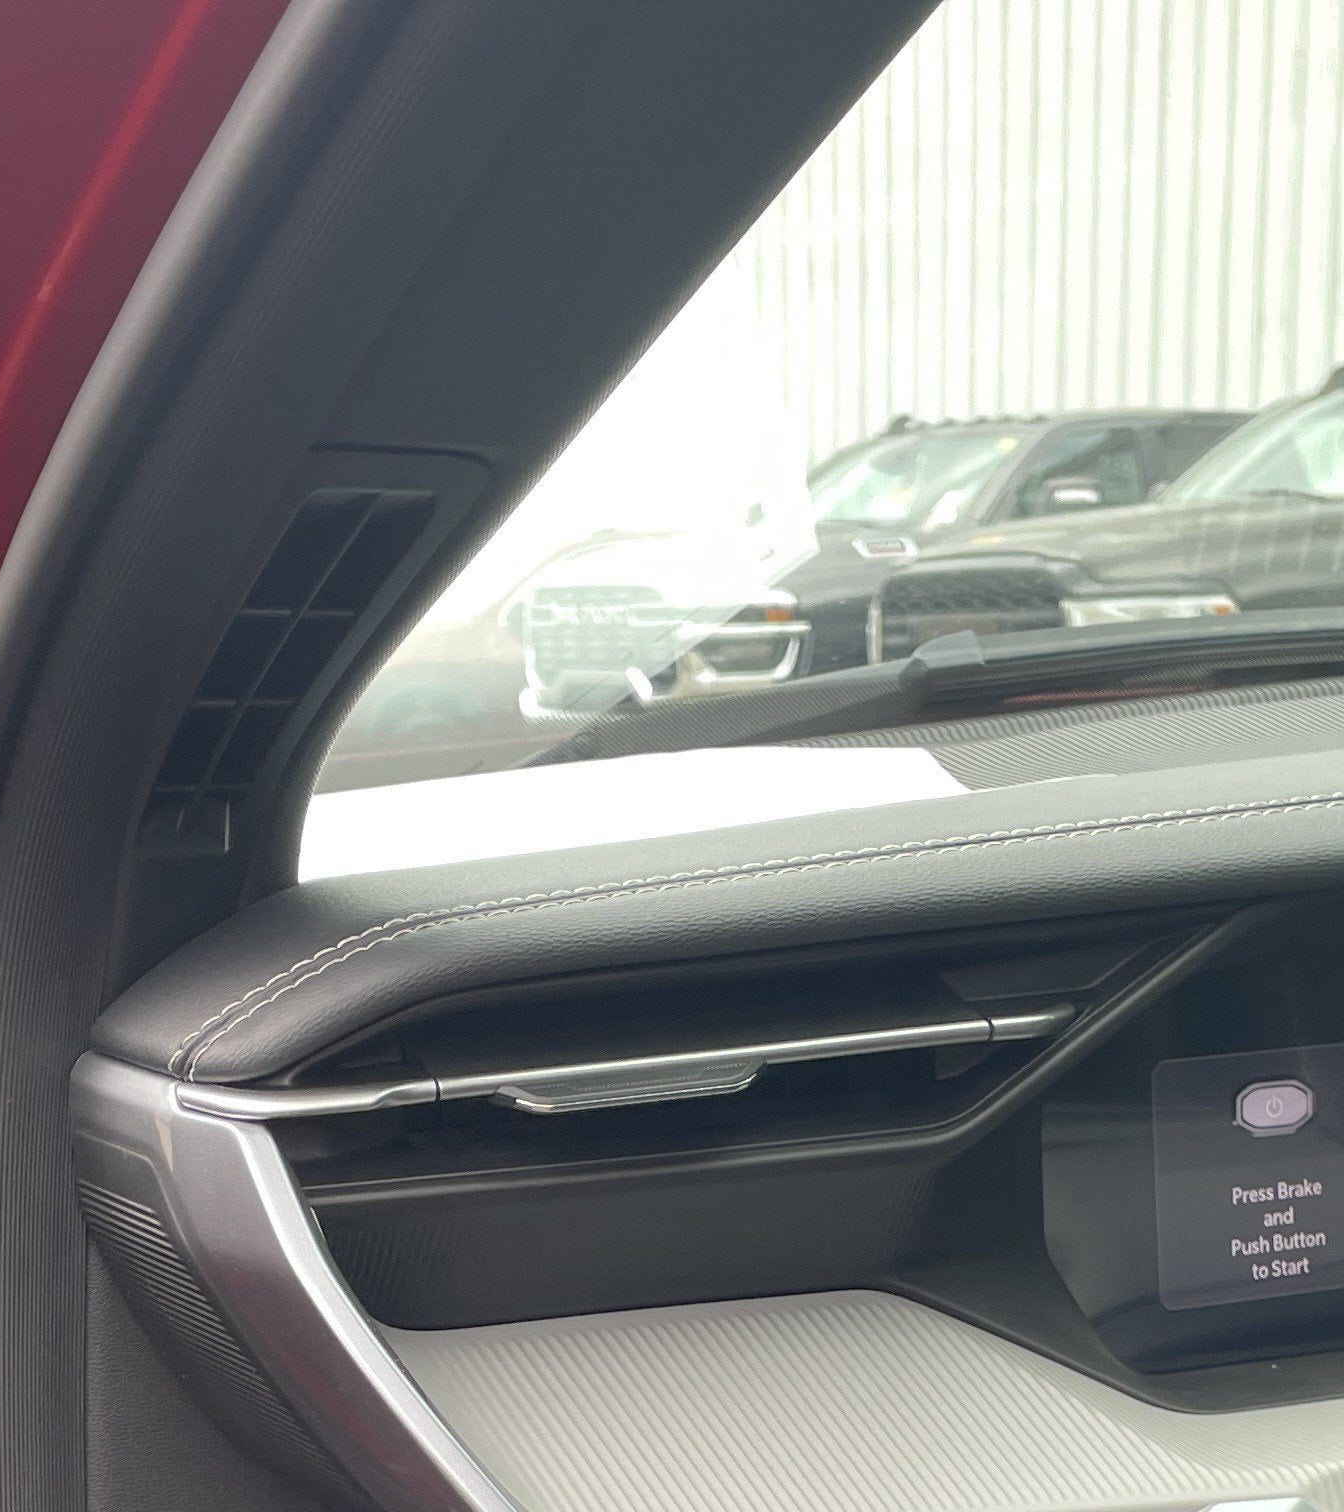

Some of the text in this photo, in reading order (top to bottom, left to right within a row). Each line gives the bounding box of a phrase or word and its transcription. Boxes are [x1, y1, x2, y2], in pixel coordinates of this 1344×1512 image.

[1232, 1179, 1323, 1205] Press Brake
[1263, 1206, 1294, 1227] and
[1231, 1232, 1327, 1257] Push Button
[1252, 1257, 1310, 1280] to Start
